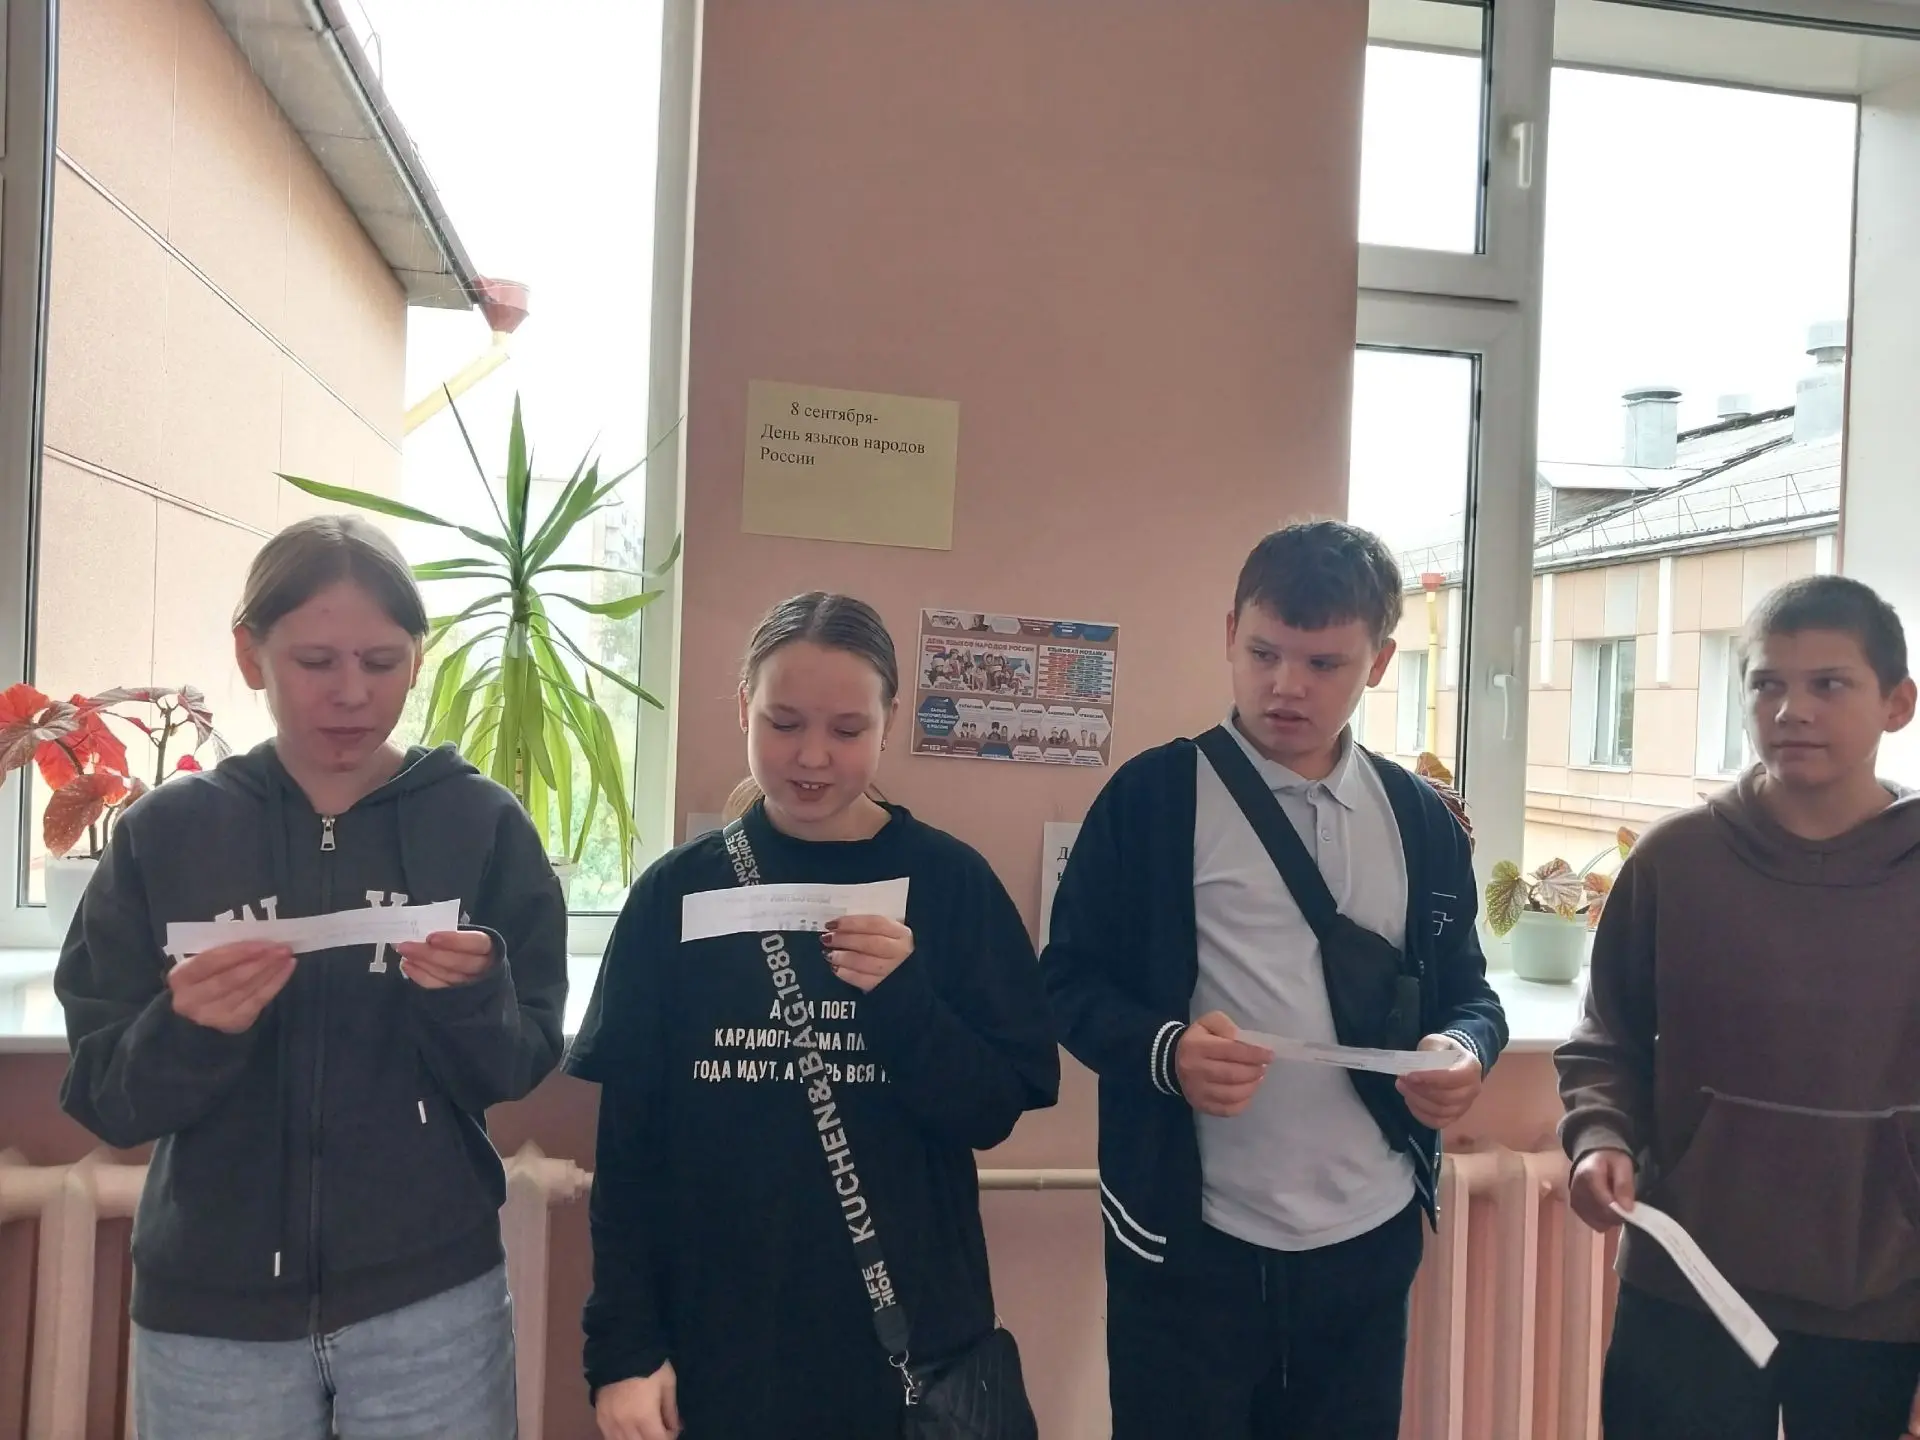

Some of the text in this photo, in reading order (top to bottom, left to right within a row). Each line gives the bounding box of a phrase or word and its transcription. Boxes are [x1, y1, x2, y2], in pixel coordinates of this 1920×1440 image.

[791, 402, 879, 426] 8 сентября-
[761, 424, 925, 454] День языков народов
[760, 447, 815, 465] России
[770, 999, 856, 1020] ДА ПОЕТ
[847, 1032, 868, 1050] ПЛ
[694, 1060, 731, 1081] ГОДА
[737, 1060, 779, 1082] ИДУТ,
[784, 1062, 795, 1080] А
[847, 1064, 875, 1083] ВСЯ
[862, 1265, 883, 1312] LIFE
